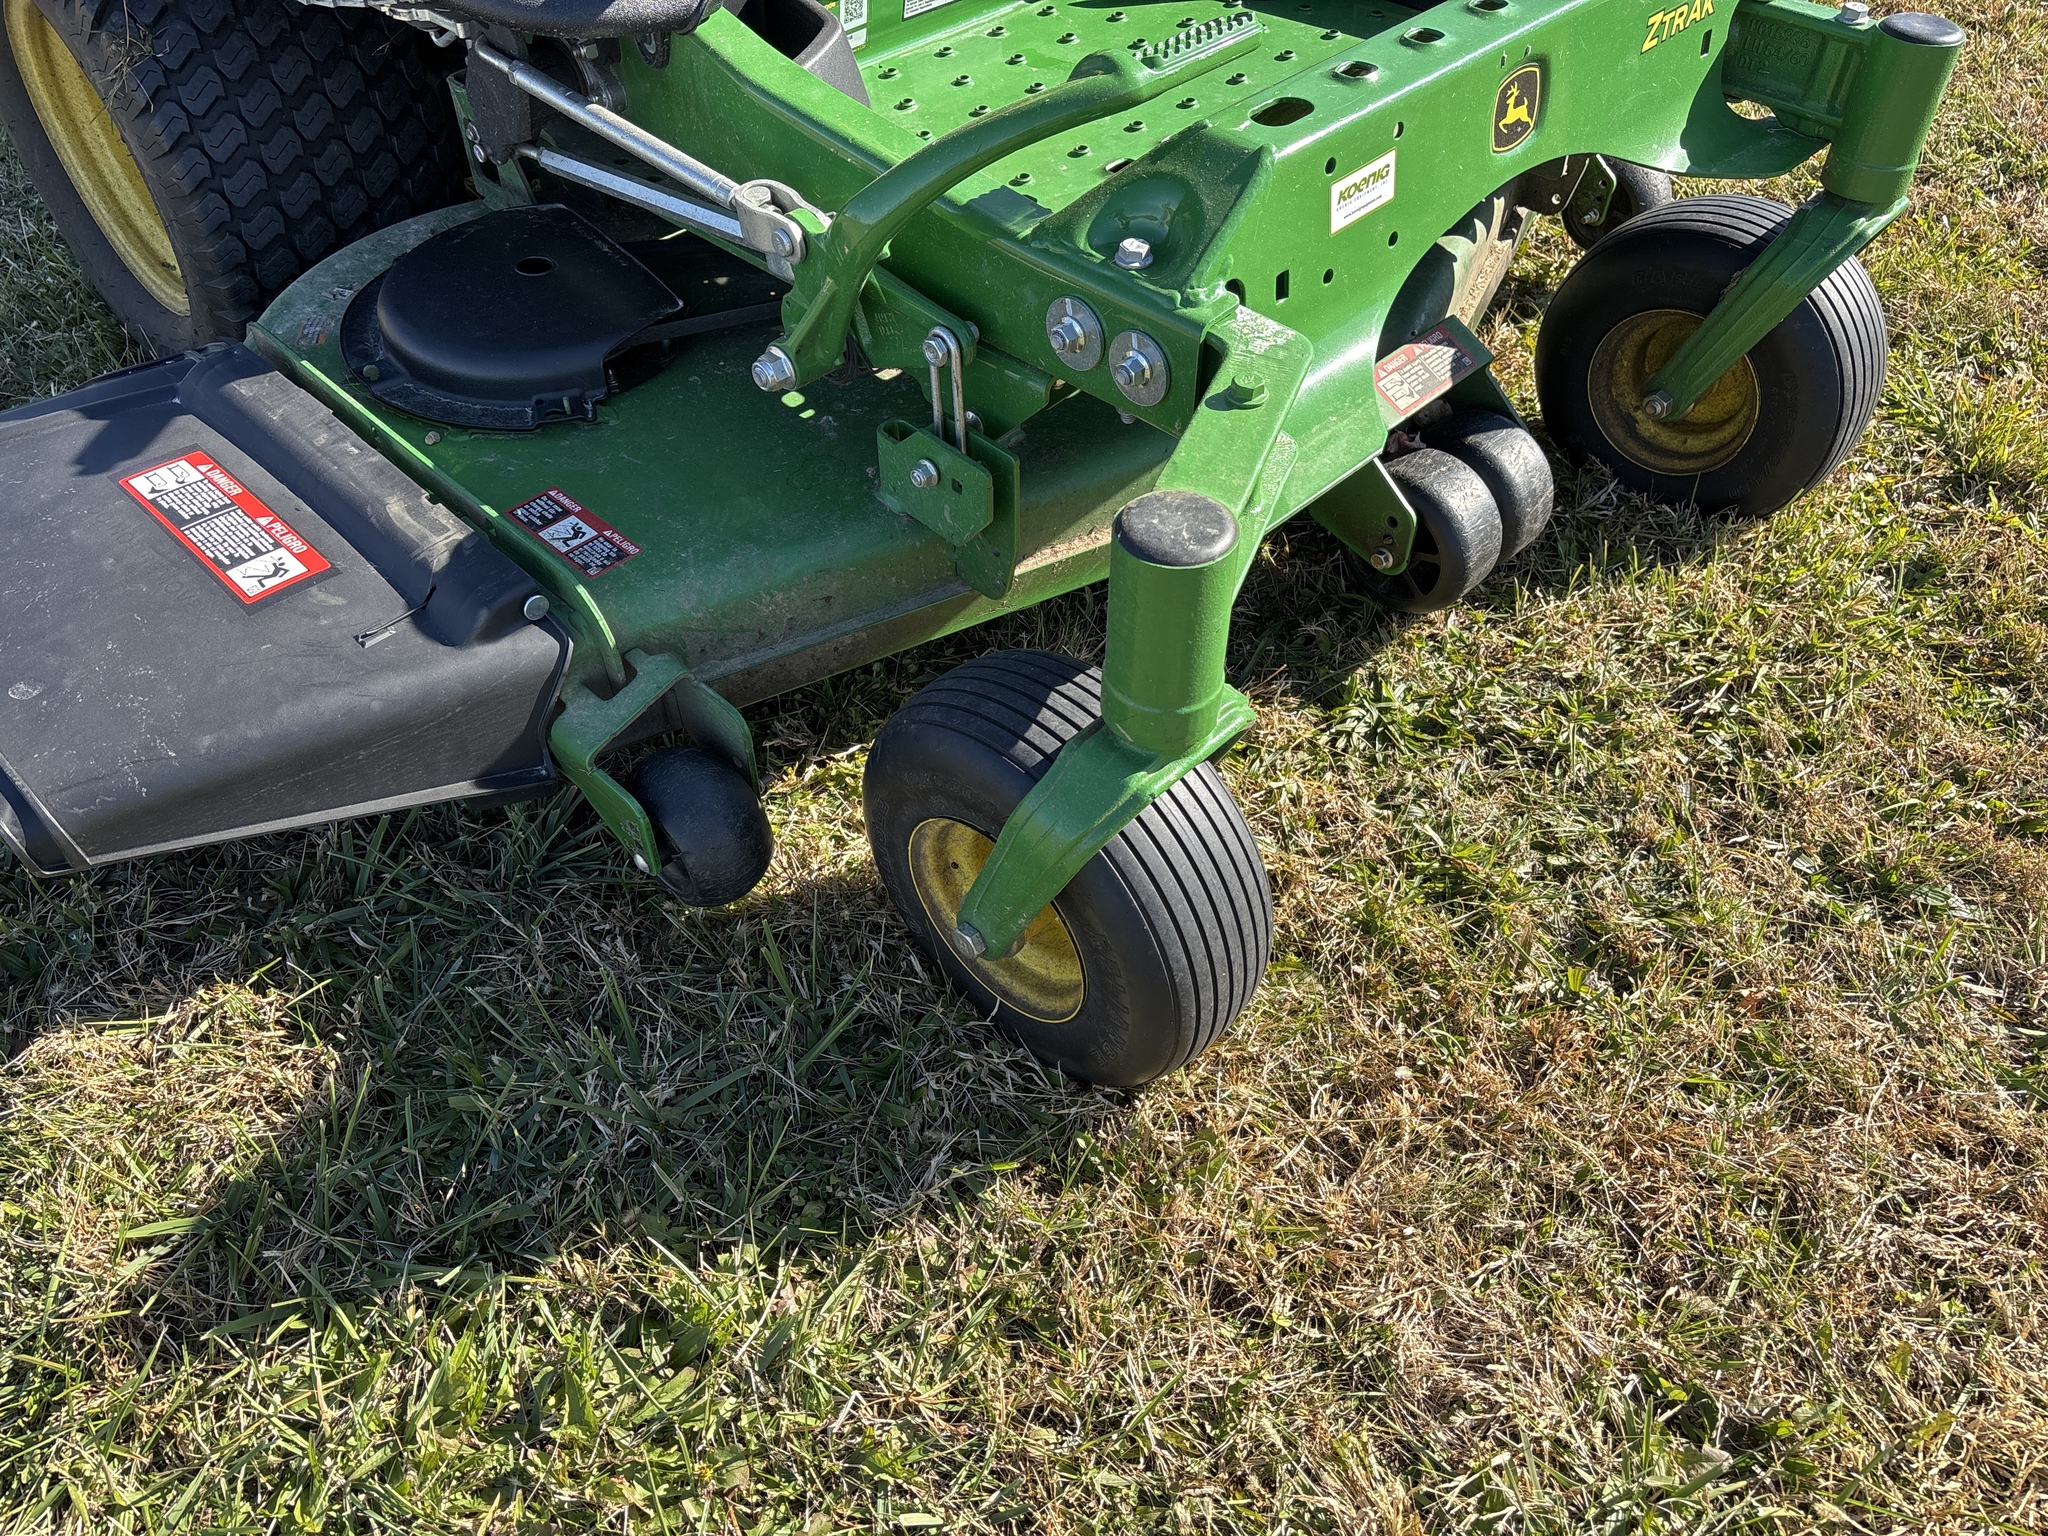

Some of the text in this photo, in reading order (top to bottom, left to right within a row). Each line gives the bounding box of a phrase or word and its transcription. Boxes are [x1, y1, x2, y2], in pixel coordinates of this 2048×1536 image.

[1640, 0, 1715, 55] ZTRAK
[1383, 353, 1408, 373] DANGER
[206, 470, 243, 497] DANGER
[555, 492, 582, 513] DANGER
[266, 522, 309, 554] PELIGRO
[609, 532, 640, 555] PELIGRO
